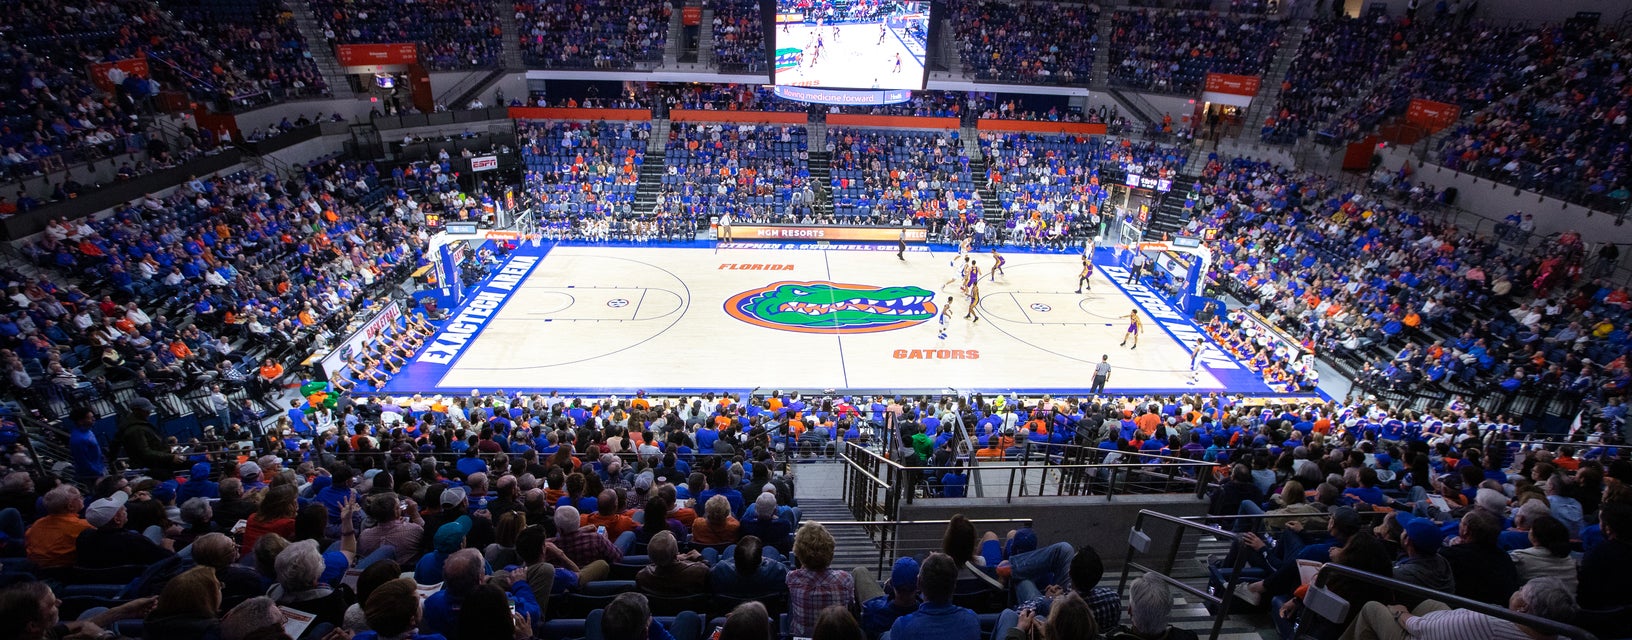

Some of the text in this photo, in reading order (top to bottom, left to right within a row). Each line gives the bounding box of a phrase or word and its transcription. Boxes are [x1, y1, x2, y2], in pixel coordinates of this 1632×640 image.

[783, 88, 805, 100] Moving
[805, 92, 842, 102] medicine
[472, 159, 496, 168] ESPN
[781, 229, 824, 237] RESORTS
[905, 231, 927, 239] WELC
[718, 263, 795, 271] FLORIDA
[416, 256, 539, 365] EXACTECH ARENA
[366, 305, 399, 340] BASKETBALL
[892, 349, 980, 360] GATORS
